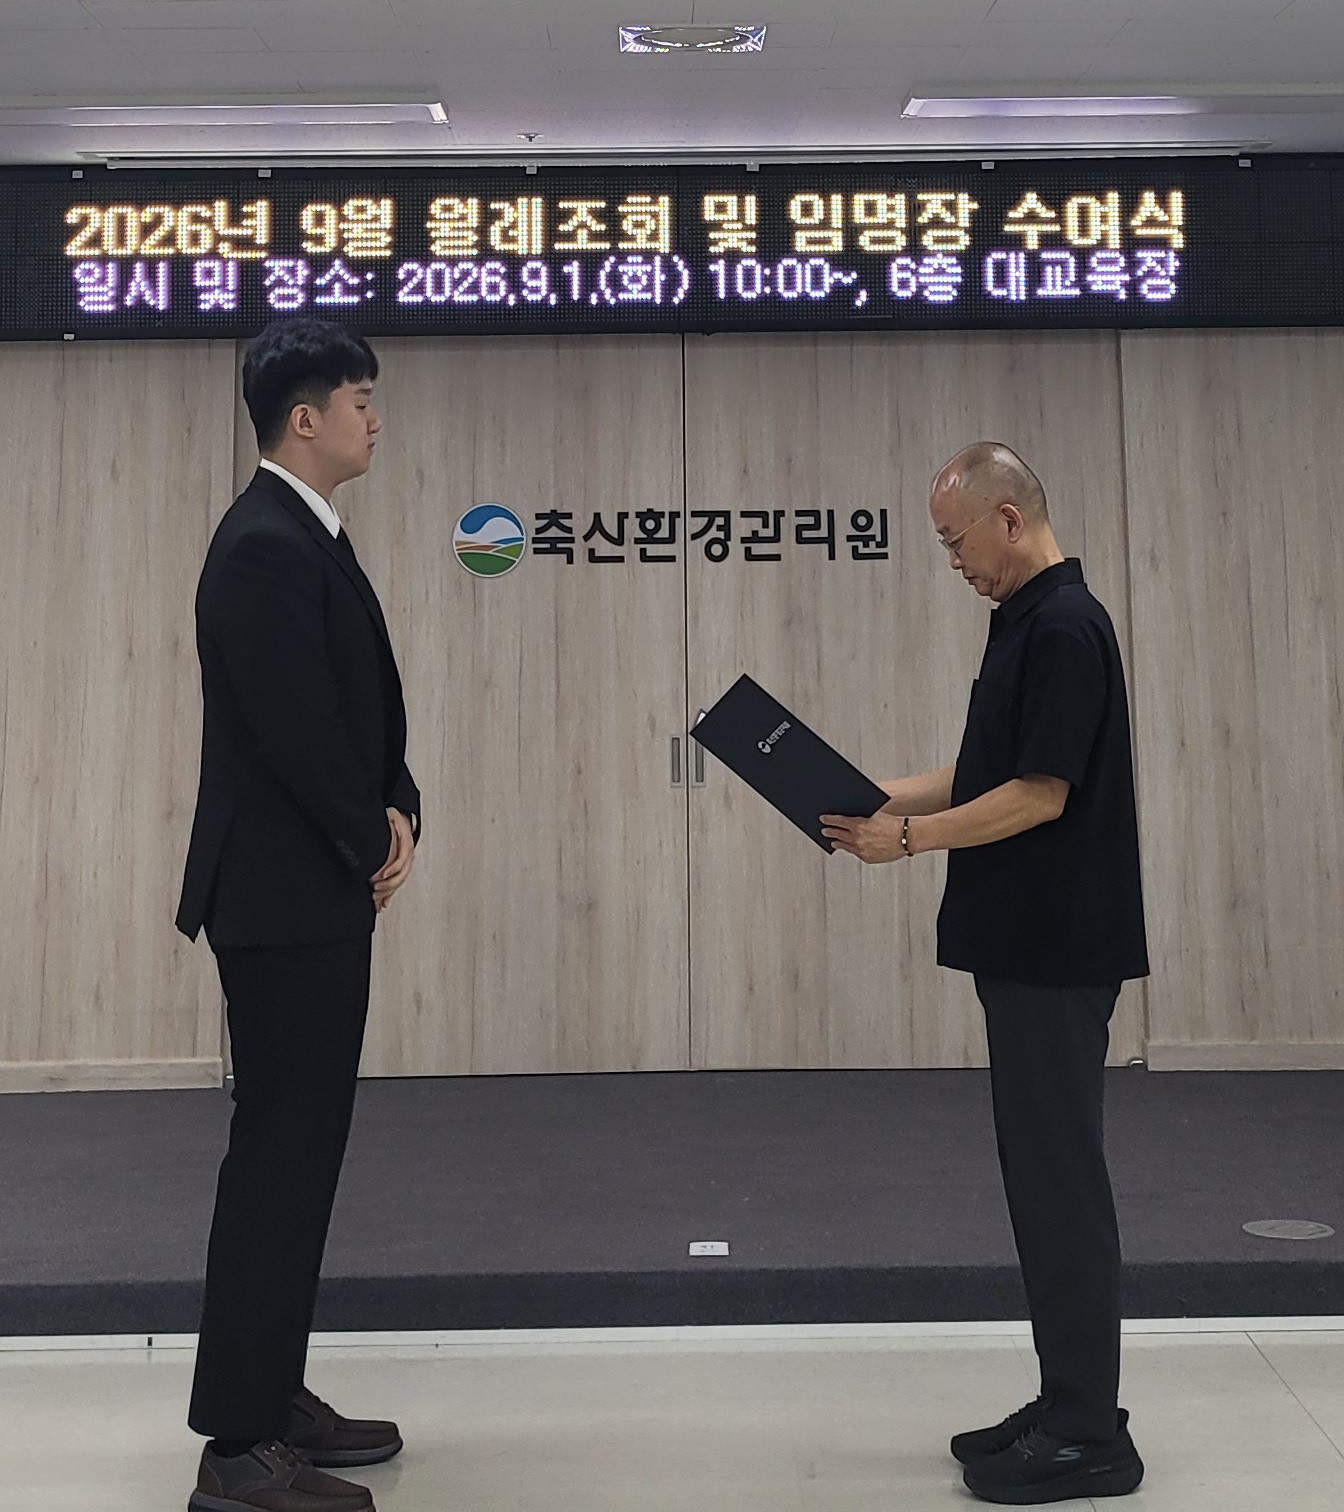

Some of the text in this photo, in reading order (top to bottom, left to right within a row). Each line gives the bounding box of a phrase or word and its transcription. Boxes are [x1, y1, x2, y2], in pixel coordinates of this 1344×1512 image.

[64, 191, 1184, 258] 2026년 9월 월례조회 및 임명장 수여식
[73, 260, 168, 312] 일시
[192, 259, 238, 311] 및
[262, 258, 376, 309] 장소:
[890, 253, 962, 303] 6층
[986, 250, 1181, 302] 대교육장
[531, 507, 890, 566] 축산환경관리원
